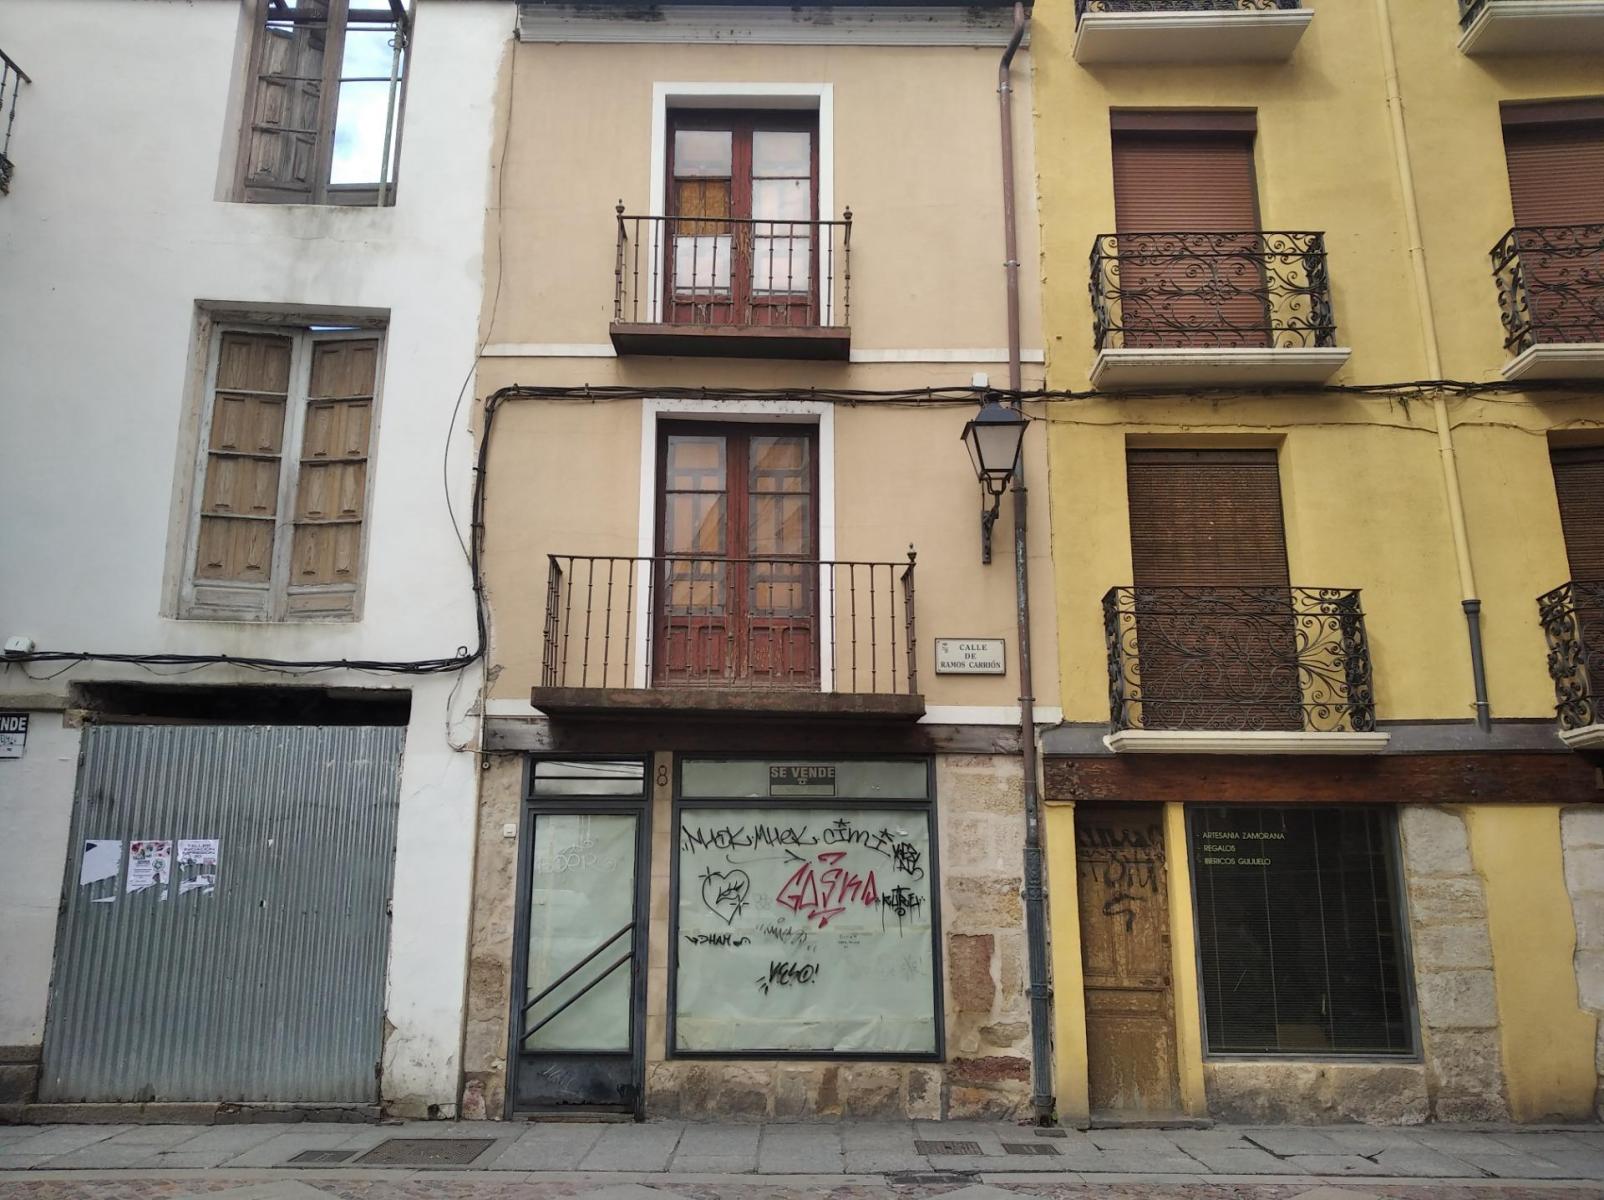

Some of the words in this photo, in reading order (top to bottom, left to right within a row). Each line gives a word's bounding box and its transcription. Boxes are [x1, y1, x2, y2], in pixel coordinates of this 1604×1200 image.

[959, 643, 988, 651] CALLE
[964, 652, 977, 660] DE
[0, 716, 27, 731] NDE
[656, 764, 669, 787] 8
[770, 767, 787, 778] SE
[791, 767, 835, 778] VENDE
[1202, 831, 1240, 839] ARTESANIA
[1242, 832, 1285, 840] ZAMORANA
[1203, 844, 1236, 852] REGALOS
[1204, 857, 1236, 865] IBERICOS
